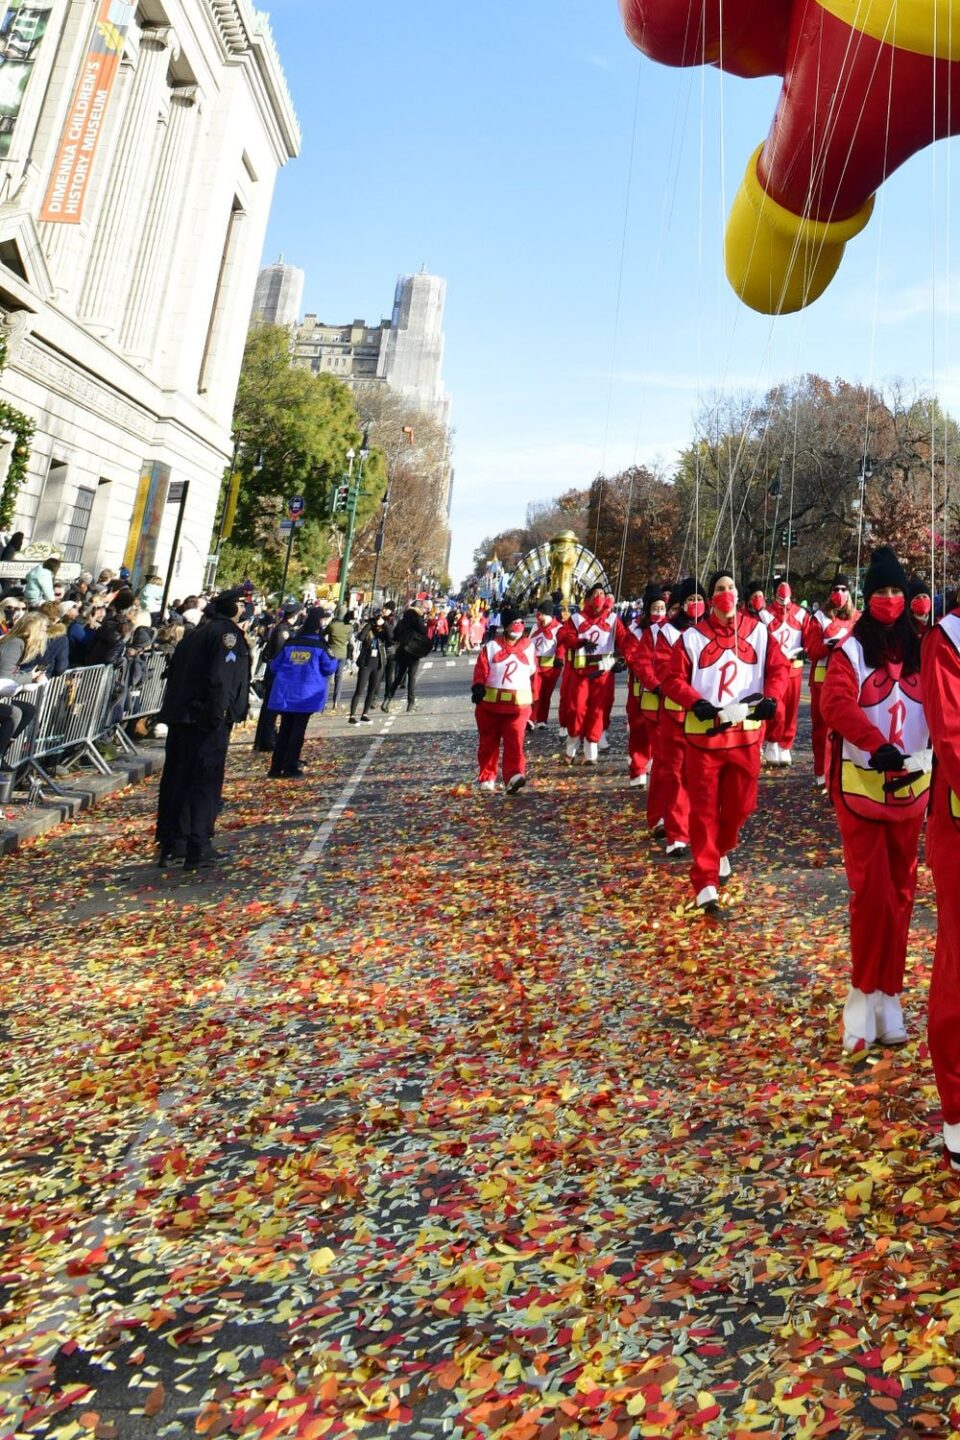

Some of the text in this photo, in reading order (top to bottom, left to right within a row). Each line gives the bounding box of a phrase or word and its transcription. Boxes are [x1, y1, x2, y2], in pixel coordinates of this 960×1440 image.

[48, 61, 100, 213] DIMENNA CHILDREN'S
[64, 89, 108, 214] HISTORY MUSEUM
[779, 629, 790, 648] R
[502, 661, 518, 685] R
[718, 661, 737, 703] R
[888, 699, 906, 753] R
